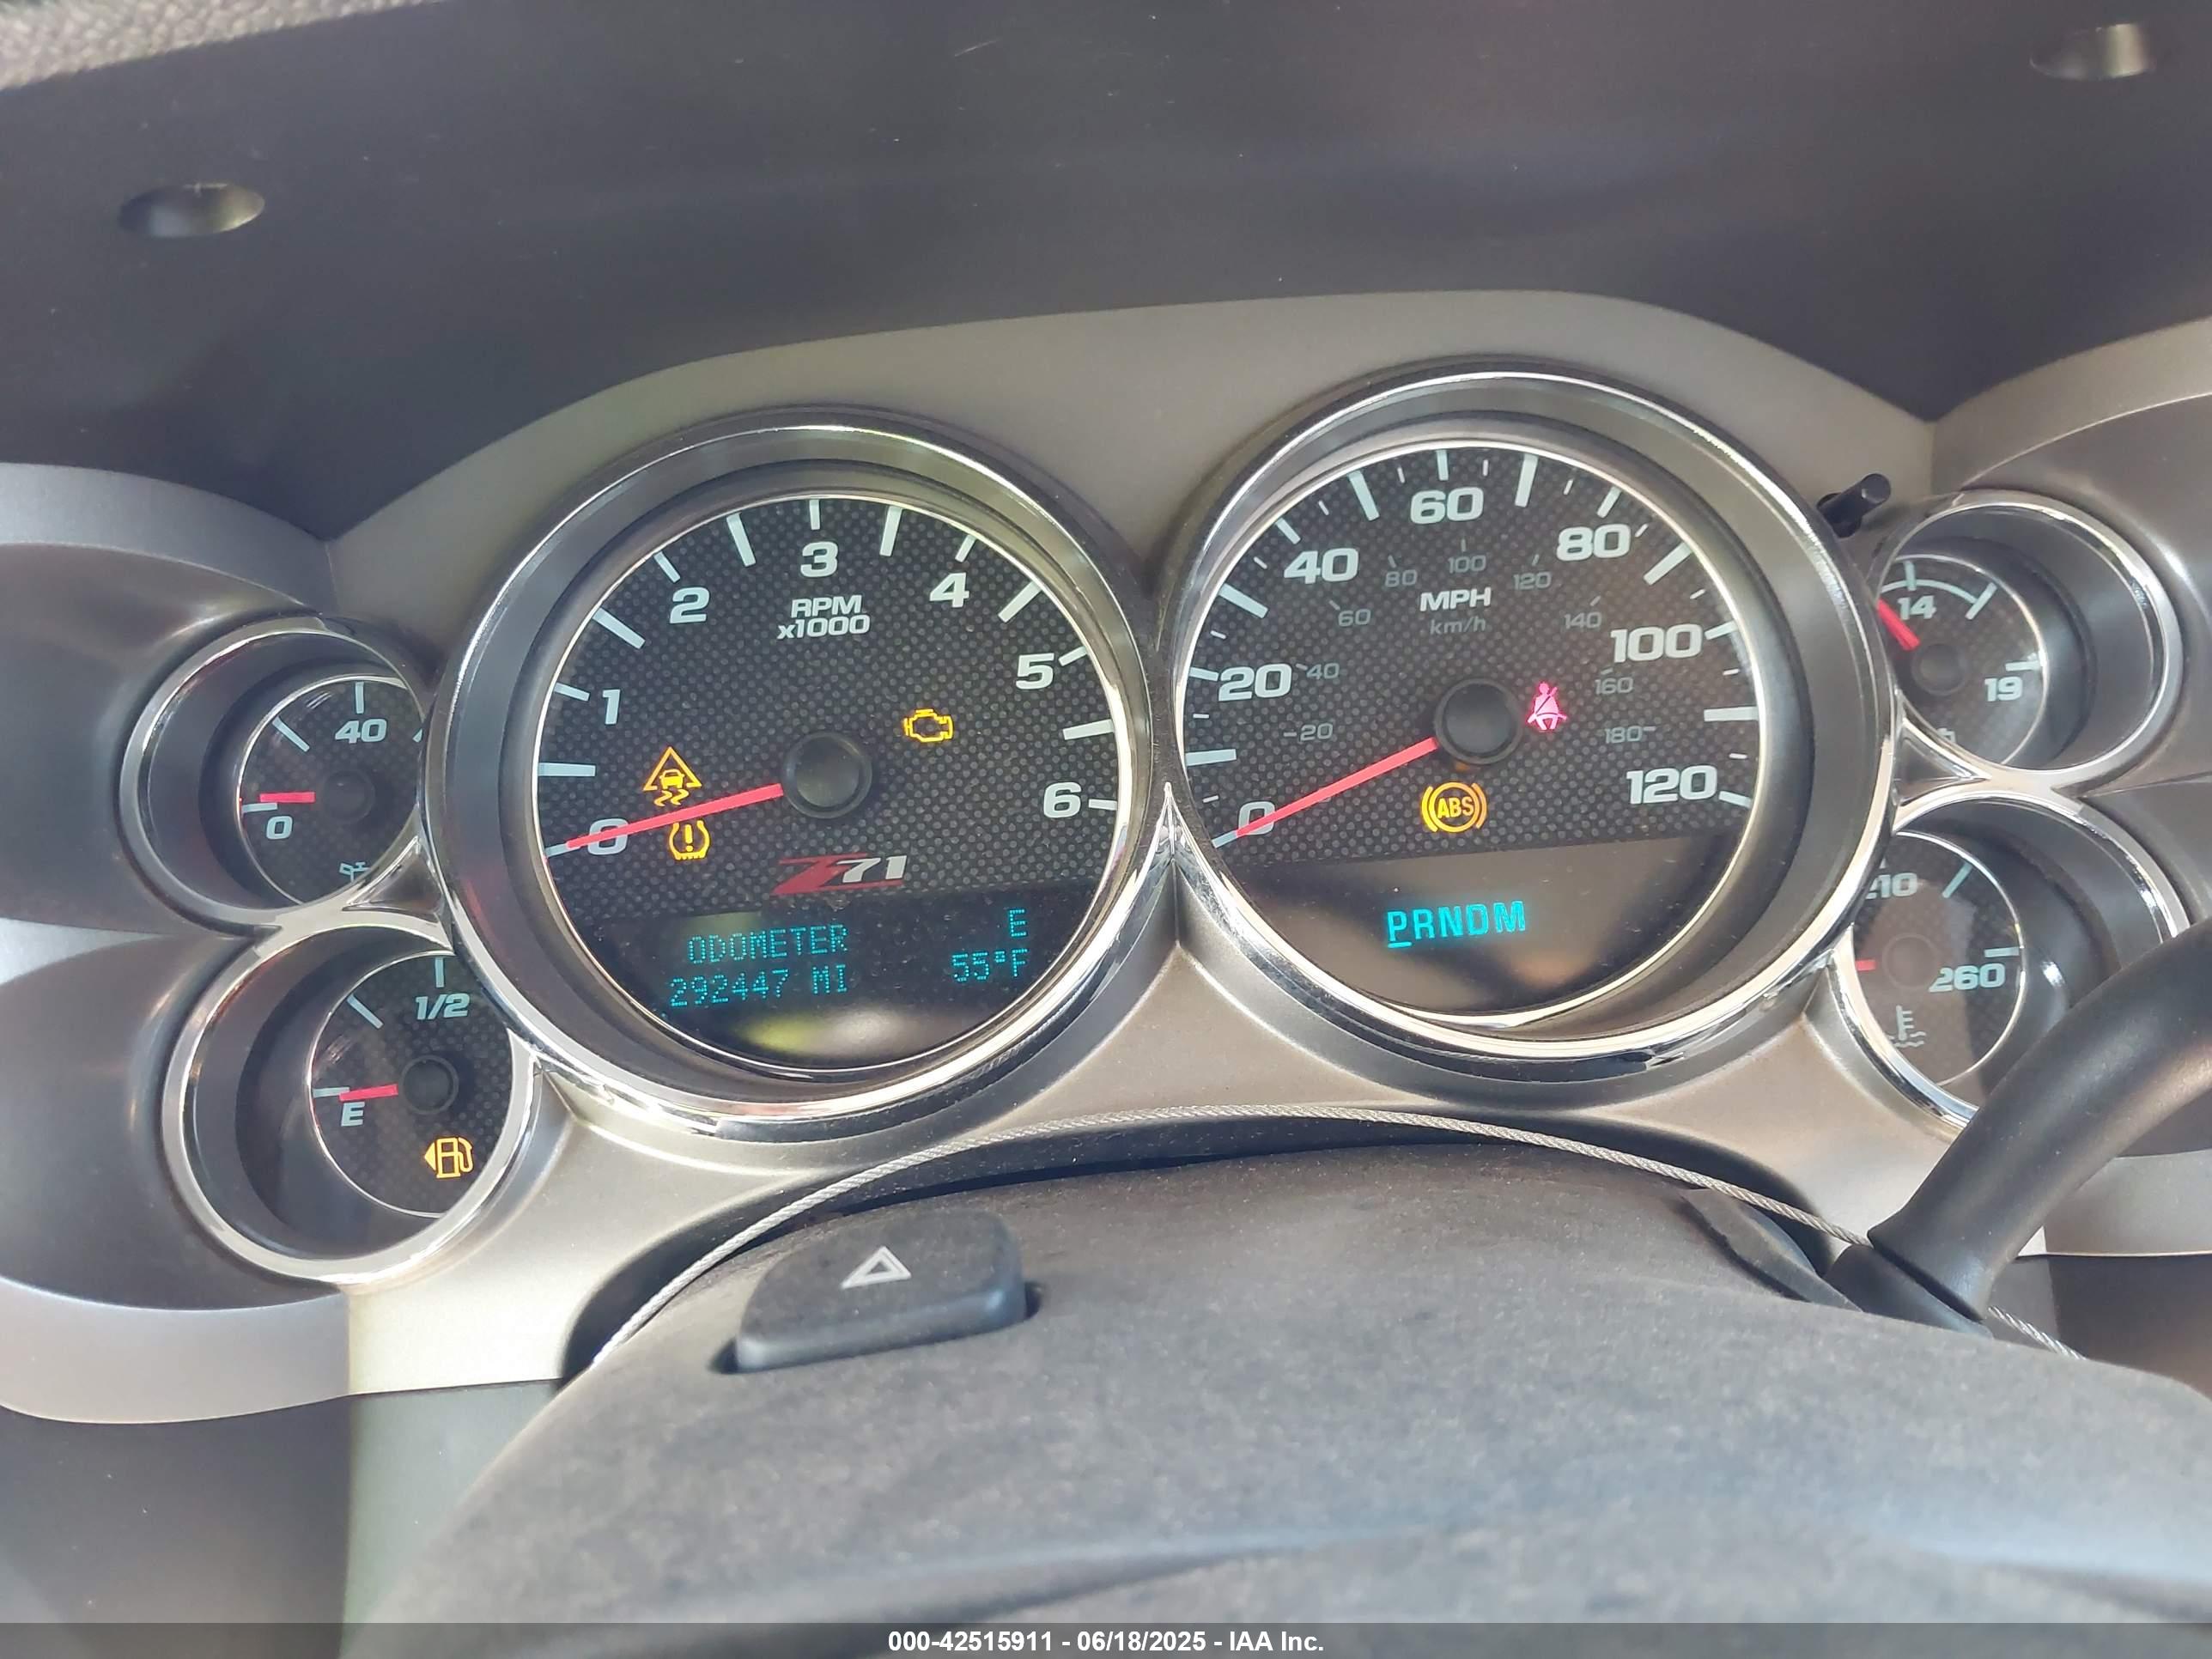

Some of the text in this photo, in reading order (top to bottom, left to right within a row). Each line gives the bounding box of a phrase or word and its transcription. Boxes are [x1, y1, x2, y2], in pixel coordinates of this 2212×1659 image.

[1410, 487, 1484, 524] 60
[1557, 524, 1631, 560] 80
[800, 542, 838, 577] 3
[1284, 548, 1358, 584] 40
[1448, 554, 1486, 574] 100
[929, 572, 969, 607] 4
[1384, 568, 1418, 587] 80
[1513, 570, 1552, 591] 120
[669, 586, 710, 623] 2
[791, 594, 862, 617] RPM
[1419, 586, 1492, 611] MPH
[1897, 595, 1936, 620] 14
[777, 613, 871, 639] x1000
[1338, 608, 1371, 627] 60
[1430, 617, 1486, 635] km/h
[1565, 609, 1602, 629] 140
[1611, 623, 1703, 663] 100
[1016, 653, 1054, 690] 5
[1218, 663, 1291, 702] 20
[1306, 661, 1340, 680] 40
[1595, 675, 1633, 695] 160
[1984, 676, 2023, 702] 19
[602, 690, 621, 724] 1
[335, 718, 387, 744] 40
[1299, 721, 1333, 741] 20
[1604, 725, 1643, 744] 180
[1043, 782, 1082, 818] 6
[1626, 765, 1717, 805] 120
[1238, 801, 1275, 836] 0
[1437, 796, 1474, 818] ABS
[265, 815, 293, 840] 0
[587, 818, 629, 855] 0
[772, 854, 908, 895] Z71
[1007, 908, 1027, 938] E
[1387, 900, 1526, 948] PRNDM
[688, 923, 848, 963] ODOMETER
[951, 948, 1028, 982] 55°F
[1929, 963, 2006, 993] 260
[670, 964, 848, 1007] 292447 MI
[415, 993, 471, 1020] 1/2
[341, 1101, 366, 1127] E
